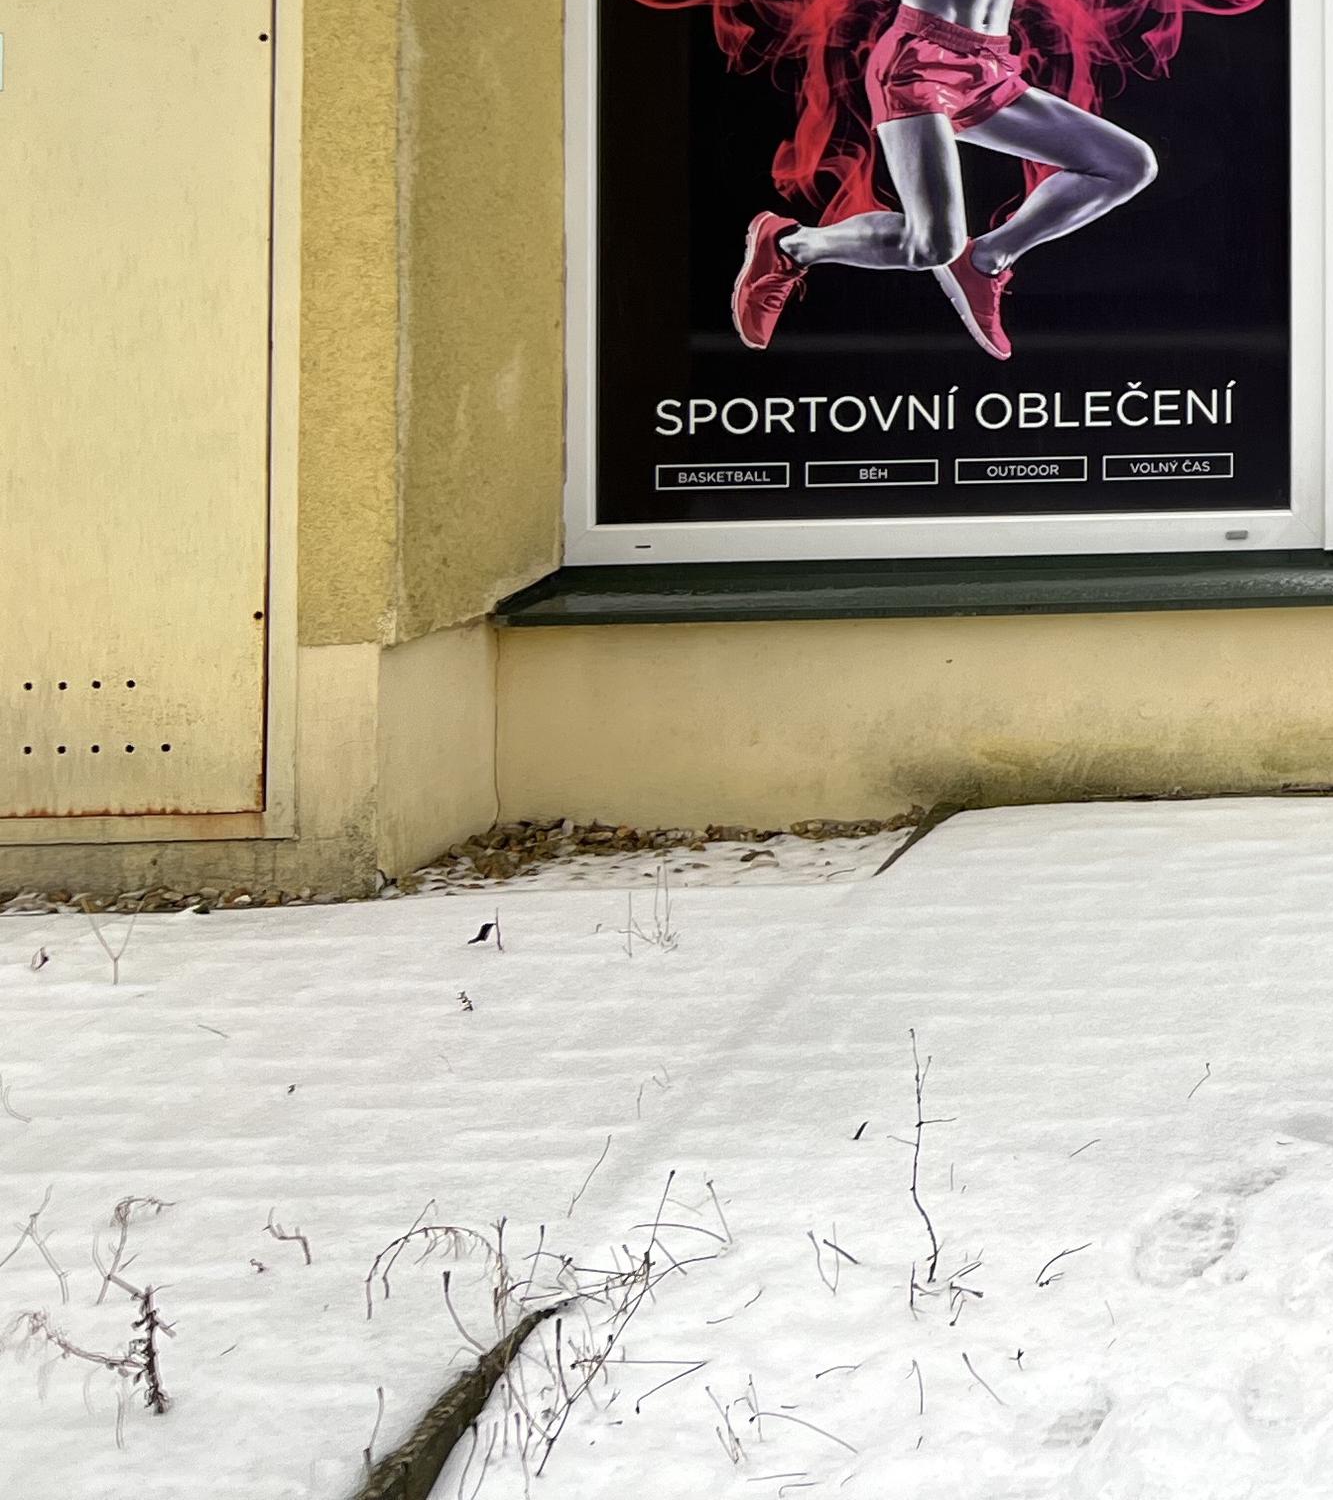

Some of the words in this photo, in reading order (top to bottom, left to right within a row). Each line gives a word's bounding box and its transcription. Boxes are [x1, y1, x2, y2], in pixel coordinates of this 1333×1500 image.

[655, 385, 958, 436] SPORTOVNÍ
[975, 379, 1237, 430] OBLEČENÍ
[858, 465, 889, 481] BĚH
[985, 463, 1059, 478] OUTDOOR
[1129, 459, 1178, 474] VOLNÝ
[1182, 457, 1211, 473] ČAS
[677, 469, 771, 484] BASKETBALL
